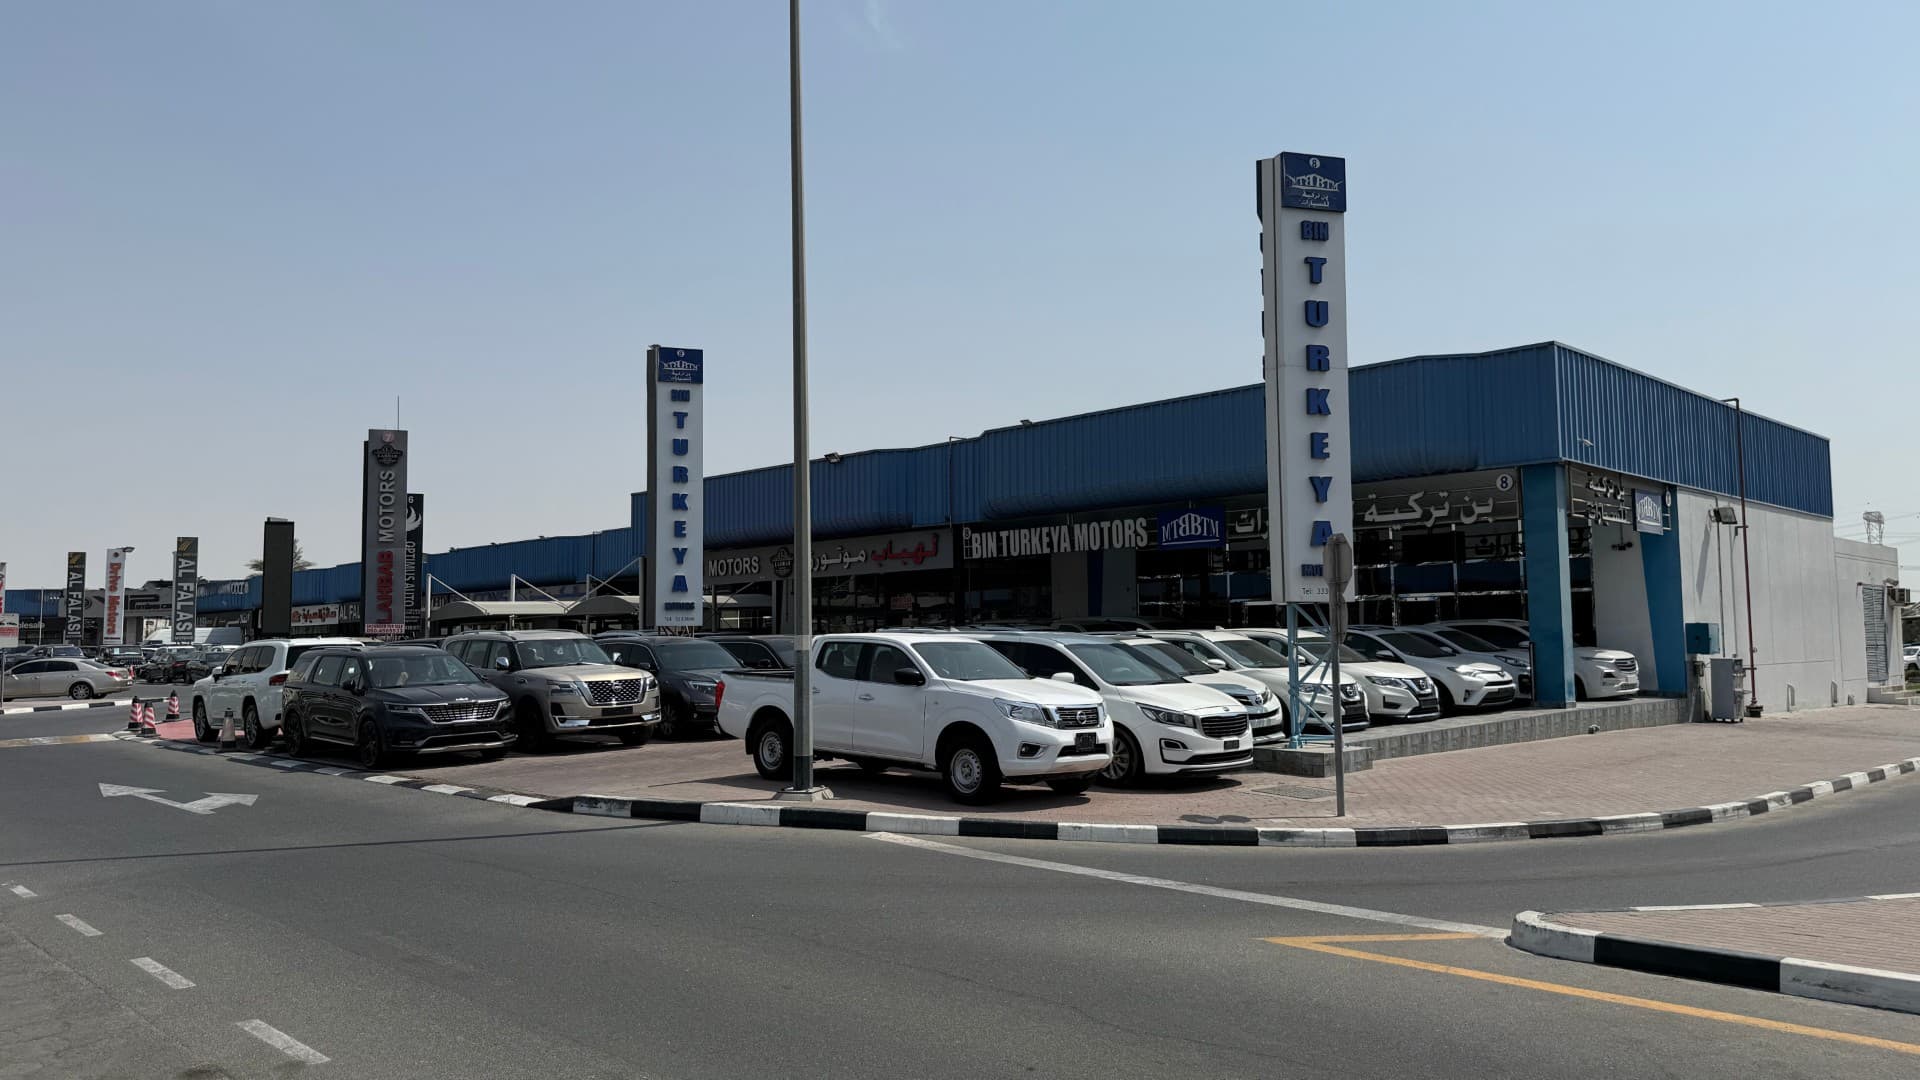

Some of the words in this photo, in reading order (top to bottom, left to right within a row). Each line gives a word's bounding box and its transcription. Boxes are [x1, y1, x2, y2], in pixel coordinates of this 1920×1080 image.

[1301, 221, 1328, 241] BIN
[1303, 256, 1333, 547] TURKEYA
[379, 470, 395, 542] MOTORS
[672, 411, 689, 593] TURKEYA
[1363, 490, 1450, 530] تركية
[1460, 493, 1494, 524] بن
[871, 533, 940, 567] لهباب
[971, 532, 998, 559] BIN
[999, 525, 1072, 557] TURKEYA
[1073, 516, 1149, 551] MOTORS
[68, 571, 83, 588] AL
[109, 562, 122, 592] Drive
[178, 558, 195, 577] AL
[405, 541, 417, 581] OPTIMUS
[708, 556, 760, 577] MOTORS
[67, 591, 82, 635] FALASI
[106, 595, 121, 635] Motors
[175, 582, 195, 636] FALASI
[404, 583, 416, 607] AUTO
